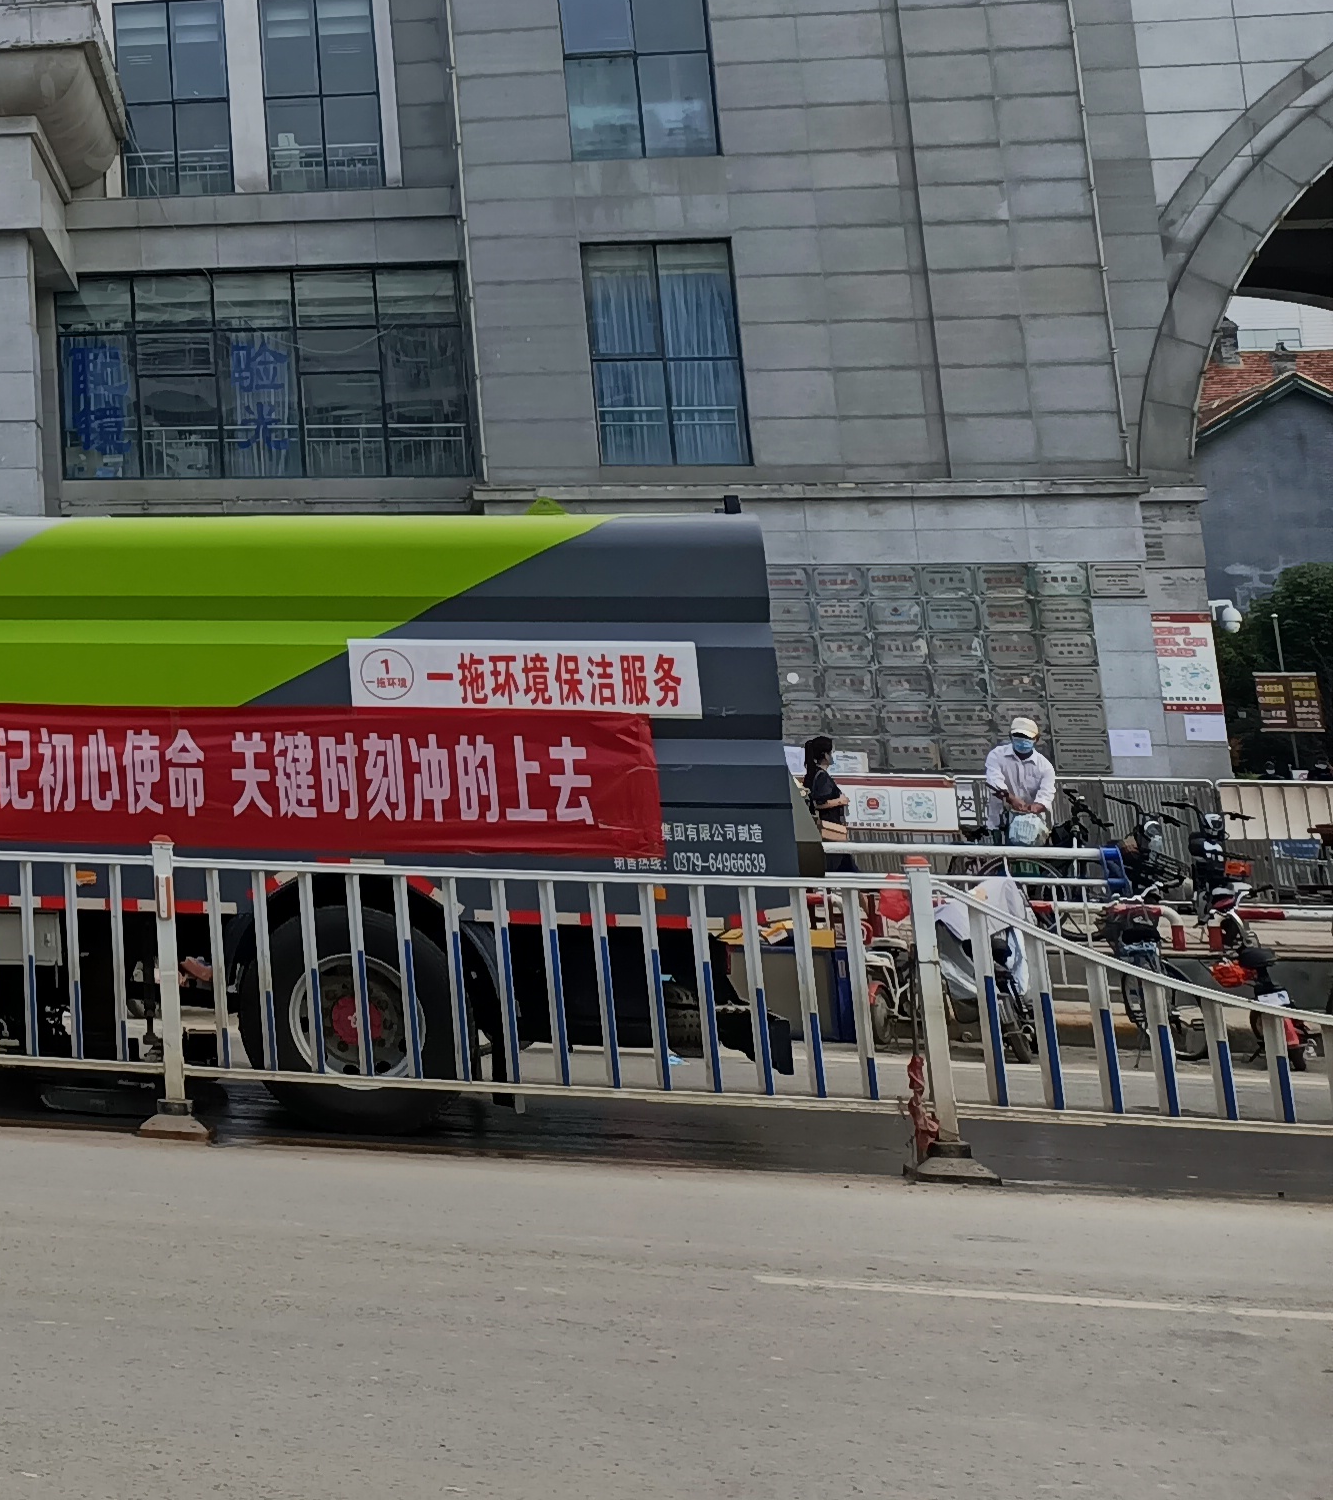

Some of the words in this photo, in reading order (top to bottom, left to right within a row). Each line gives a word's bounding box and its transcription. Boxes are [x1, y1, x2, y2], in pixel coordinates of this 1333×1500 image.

[365, 677, 408, 689] 一拖环境
[380, 658, 390, 675] 1
[427, 653, 682, 708] 一拖环境保洁服务
[232, 731, 595, 826] 关键时刻冲的上去
